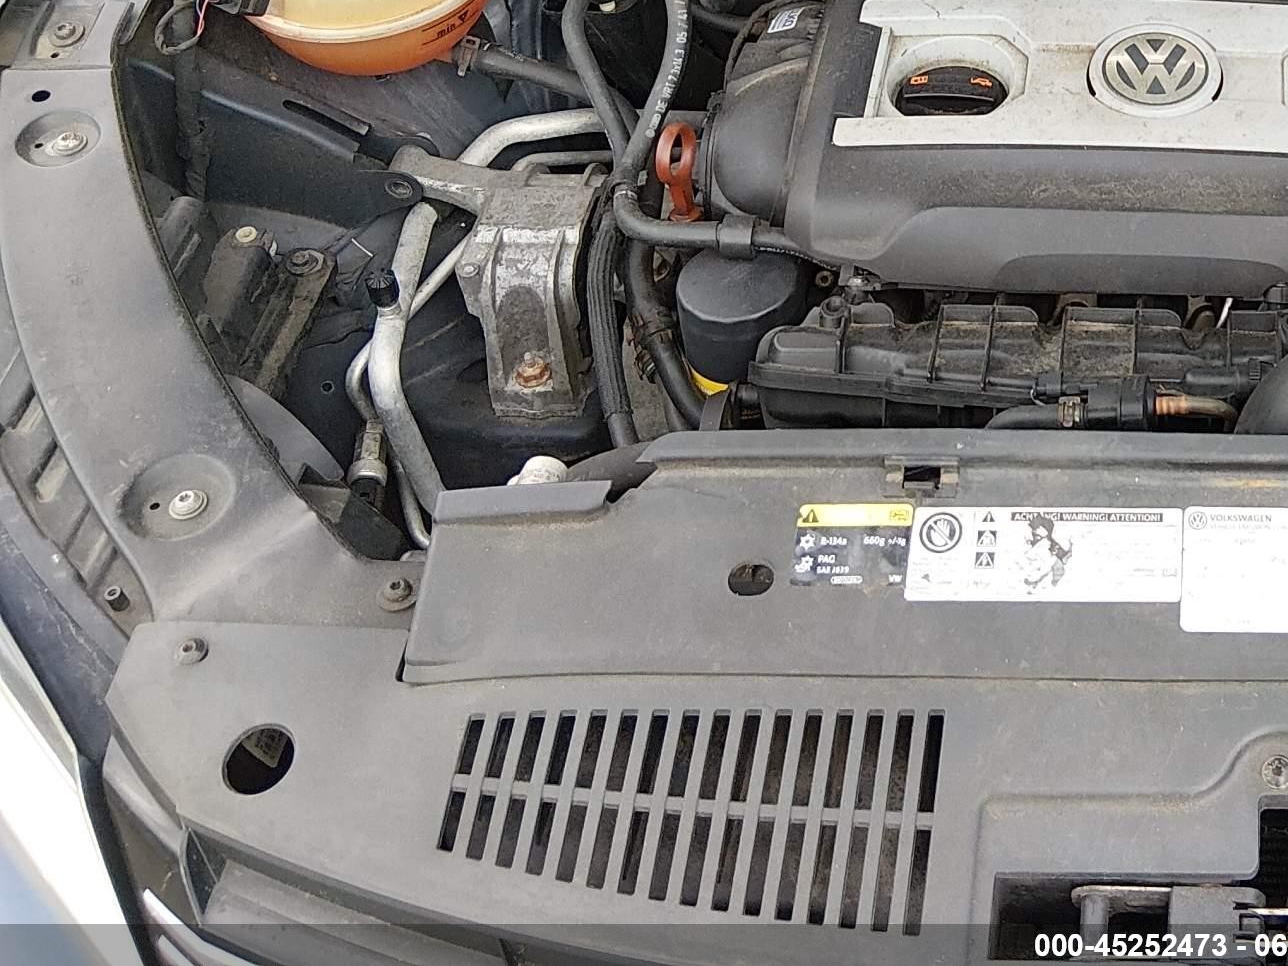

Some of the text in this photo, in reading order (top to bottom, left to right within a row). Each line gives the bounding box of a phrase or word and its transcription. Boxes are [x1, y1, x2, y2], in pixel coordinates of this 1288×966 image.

[436, 21, 457, 39] min
[1062, 512, 1109, 523] WARNING!
[1110, 513, 1162, 523] ATTENTION!
[1209, 514, 1272, 523] VOLKSWAGEN
